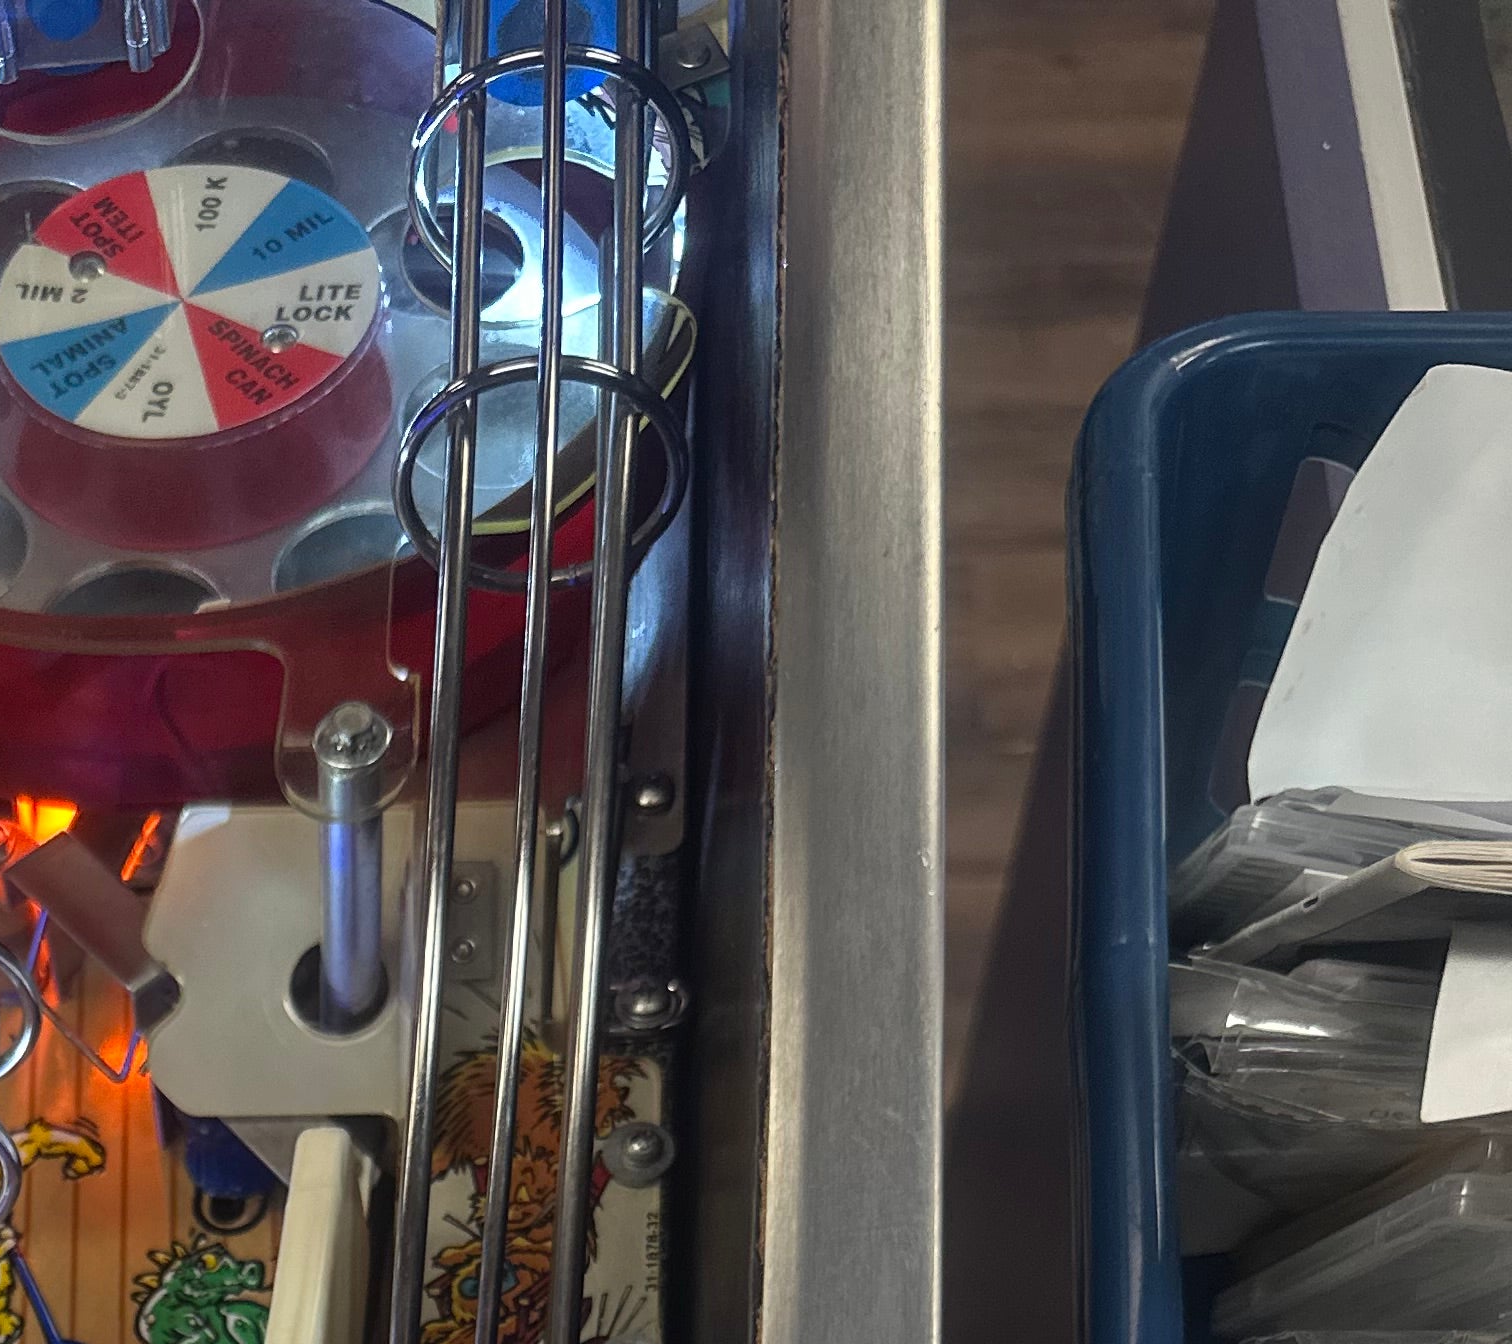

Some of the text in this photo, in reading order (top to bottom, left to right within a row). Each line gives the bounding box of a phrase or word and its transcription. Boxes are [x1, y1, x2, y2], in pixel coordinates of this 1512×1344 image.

[92, 196, 145, 241] ITEM
[196, 176, 229, 231] 100 K
[70, 210, 125, 259] SPOT
[252, 210, 336, 262] 10 MIL
[15, 282, 89, 304] 2 MIL
[276, 304, 353, 322] LOCK
[298, 283, 363, 301] LITE
[31, 318, 128, 373] ANIMAL
[208, 319, 299, 391] SPINACH
[49, 356, 117, 400] SPOT
[225, 368, 273, 405] CAN
[141, 380, 174, 423] OYL
